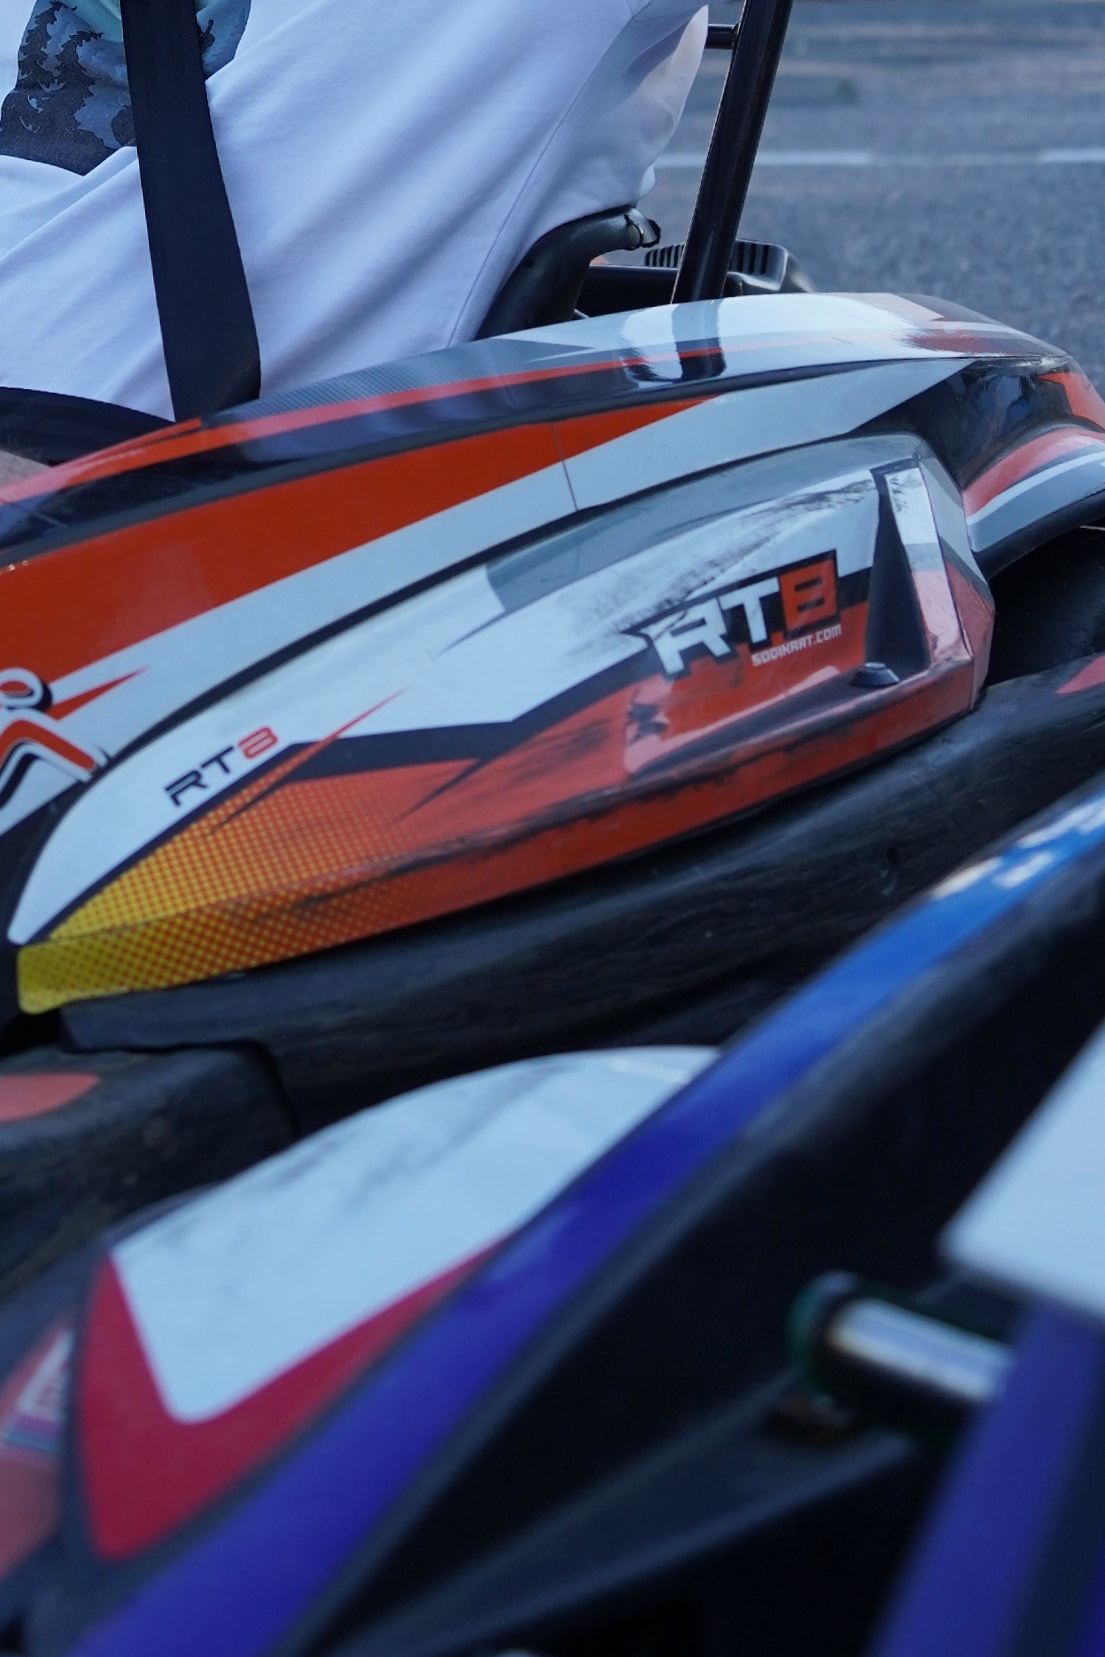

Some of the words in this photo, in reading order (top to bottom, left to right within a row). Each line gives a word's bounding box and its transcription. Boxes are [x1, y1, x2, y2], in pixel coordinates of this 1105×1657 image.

[640, 558, 839, 675] RT8
[751, 624, 842, 667] SODIKART.COM
[164, 726, 279, 807] RT8
